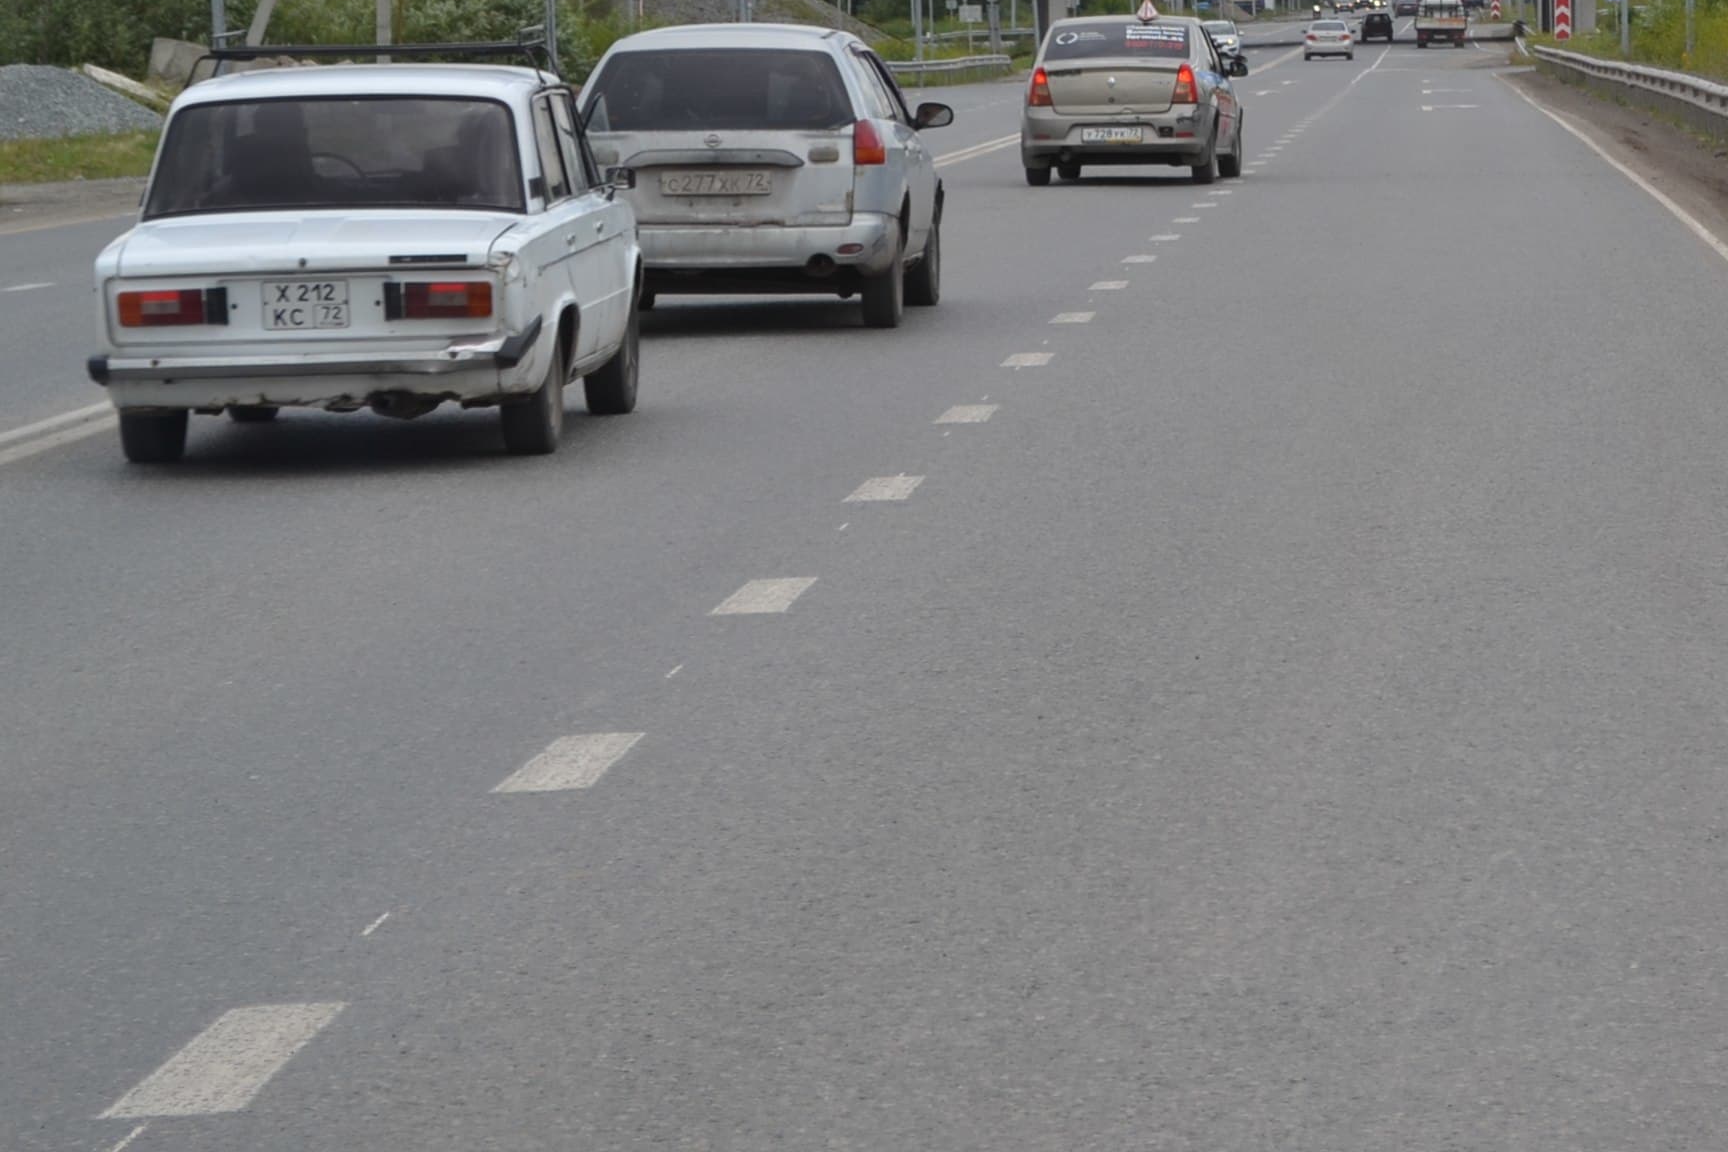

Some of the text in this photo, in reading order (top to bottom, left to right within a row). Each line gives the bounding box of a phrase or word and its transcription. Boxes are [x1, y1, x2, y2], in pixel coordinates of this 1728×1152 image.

[298, 283, 336, 302] 212
[273, 306, 343, 326] КС 72
